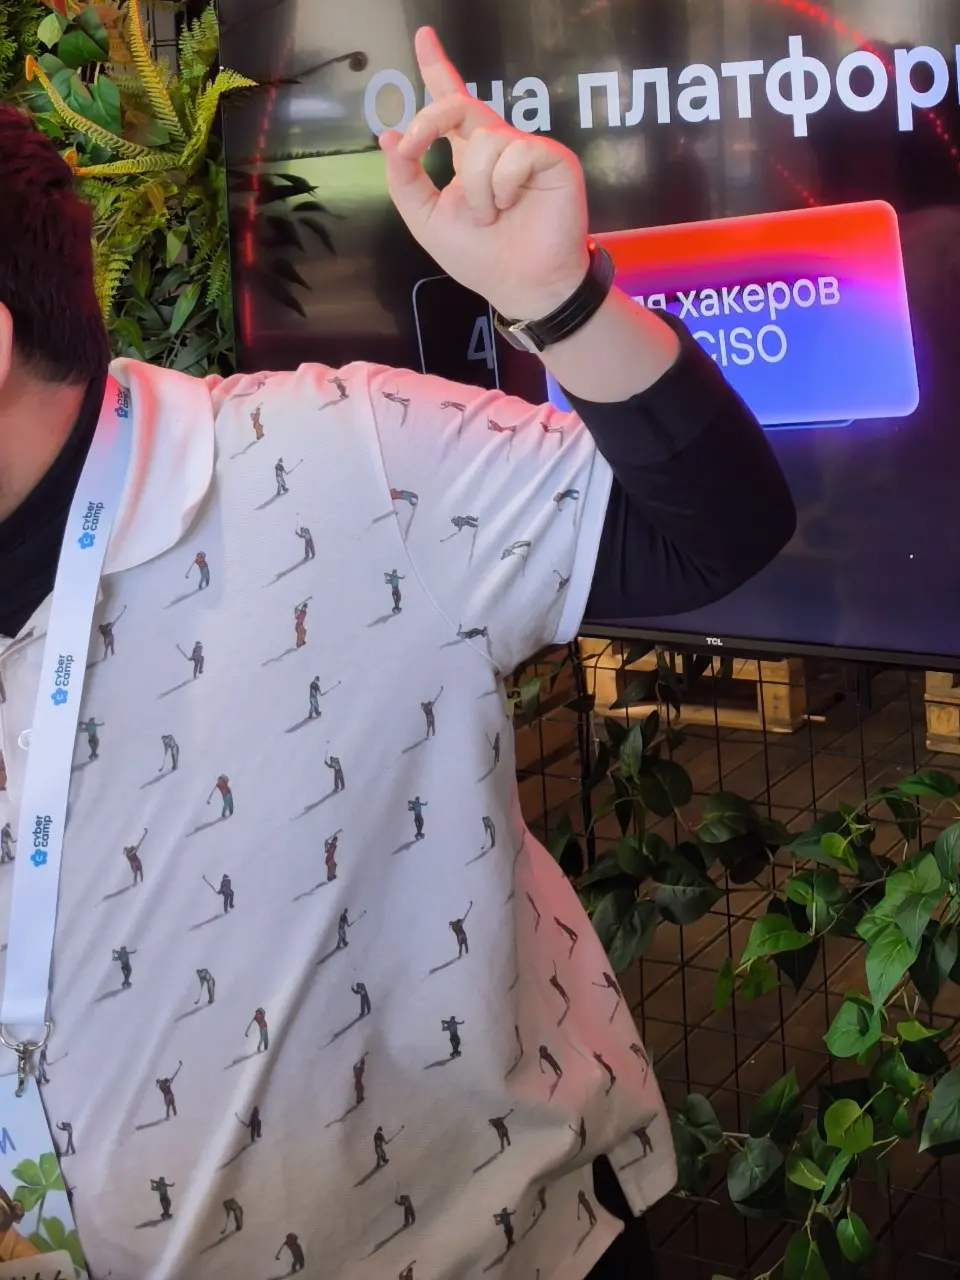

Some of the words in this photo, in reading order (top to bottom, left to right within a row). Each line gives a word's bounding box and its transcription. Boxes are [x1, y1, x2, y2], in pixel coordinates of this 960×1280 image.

[364, 69, 552, 138] Она
[676, 276, 841, 321] хакеров
[691, 323, 788, 367] CISO
[83, 501, 95, 530] cyber
[90, 501, 104, 531] camp
[706, 637, 723, 646] TCL
[55, 654, 65, 686] cyber
[62, 655, 75, 686] camp
[32, 815, 43, 847] cyber
[41, 815, 53, 847] camp
